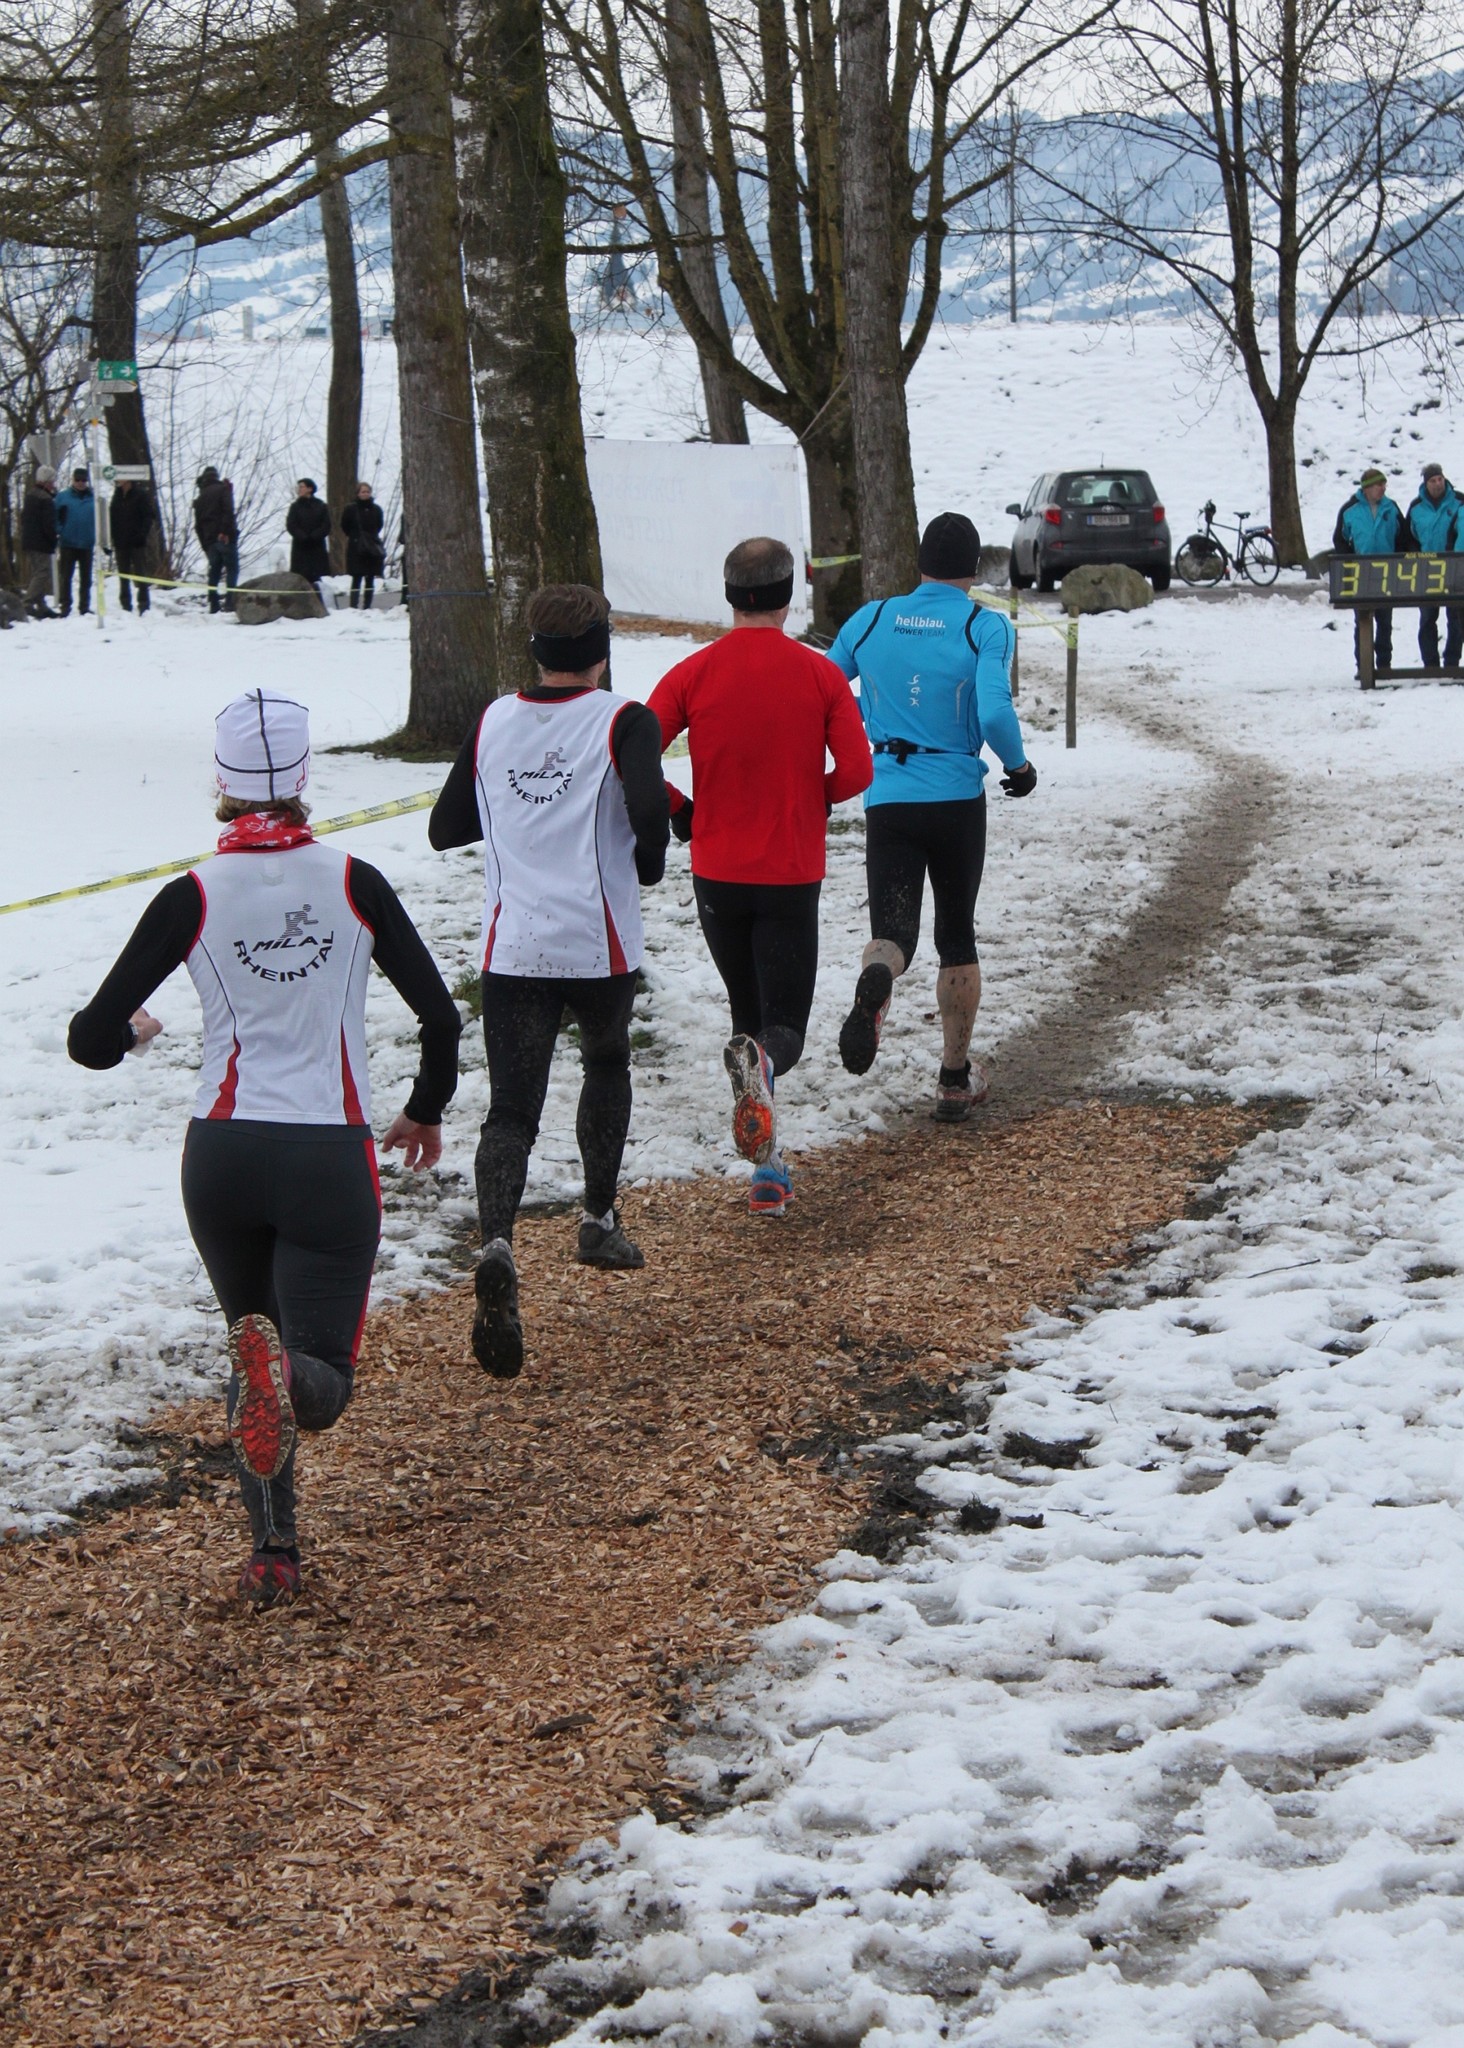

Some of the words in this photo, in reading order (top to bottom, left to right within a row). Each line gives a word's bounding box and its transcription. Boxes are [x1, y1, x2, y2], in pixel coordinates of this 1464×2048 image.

[895, 614, 946, 629] hellblau.
[507, 767, 574, 805] RHEINTAL
[233, 930, 334, 982] RHEINTAL
